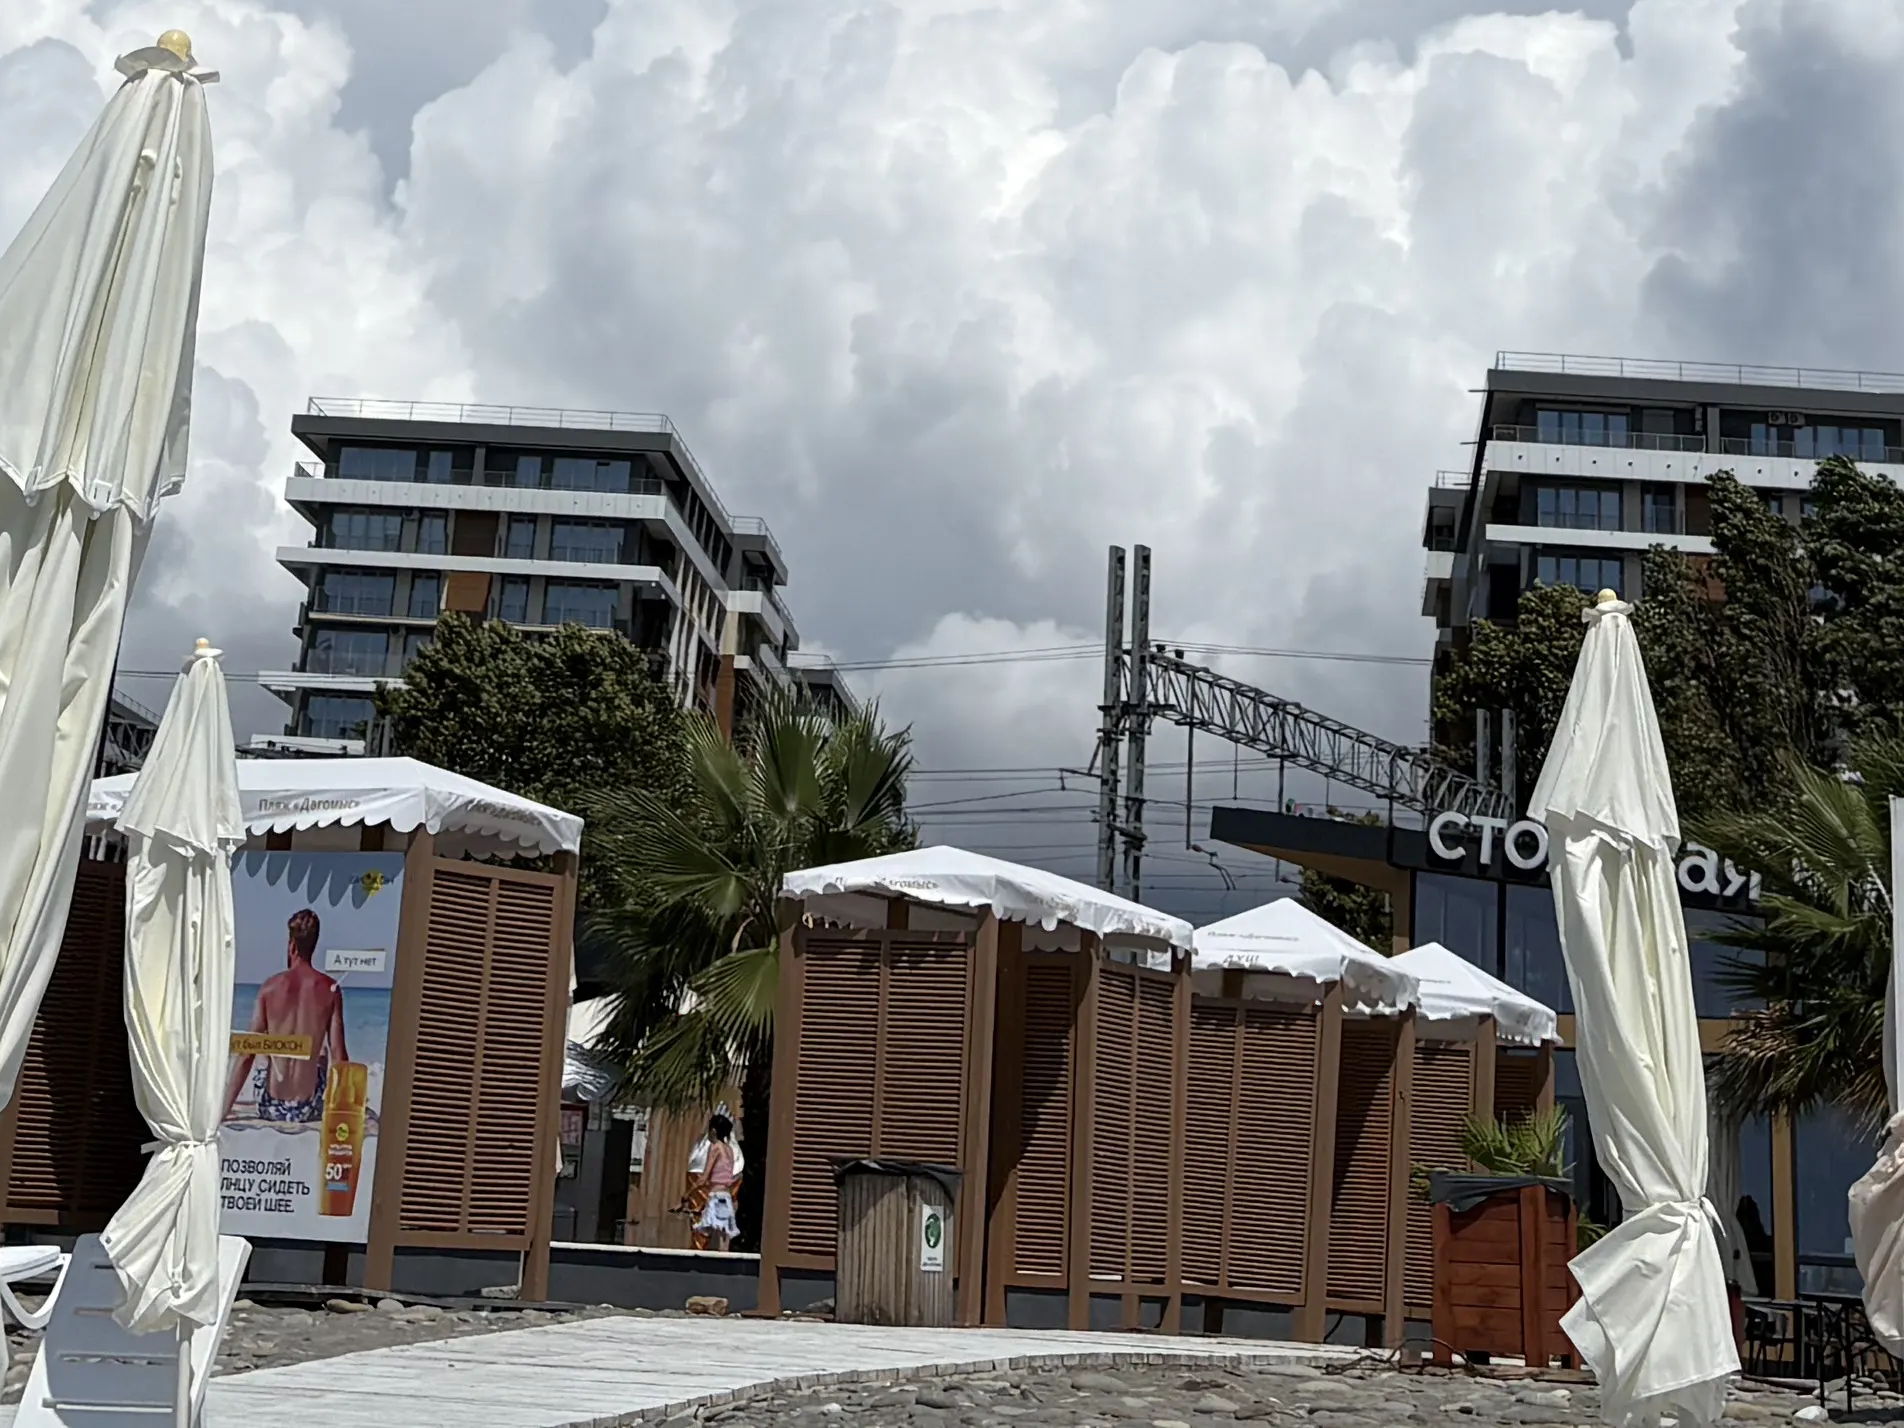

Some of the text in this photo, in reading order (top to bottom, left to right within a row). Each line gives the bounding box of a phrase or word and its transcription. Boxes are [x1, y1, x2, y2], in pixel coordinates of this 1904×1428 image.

[334, 954, 377, 969] А тут нет
[221, 1158, 291, 1175] ПОЗВОЛЯЙ
[325, 1163, 342, 1180] 50
[258, 1179, 310, 1195] СИДЕТЬ
[221, 1194, 261, 1210] ТВОЕЙ
